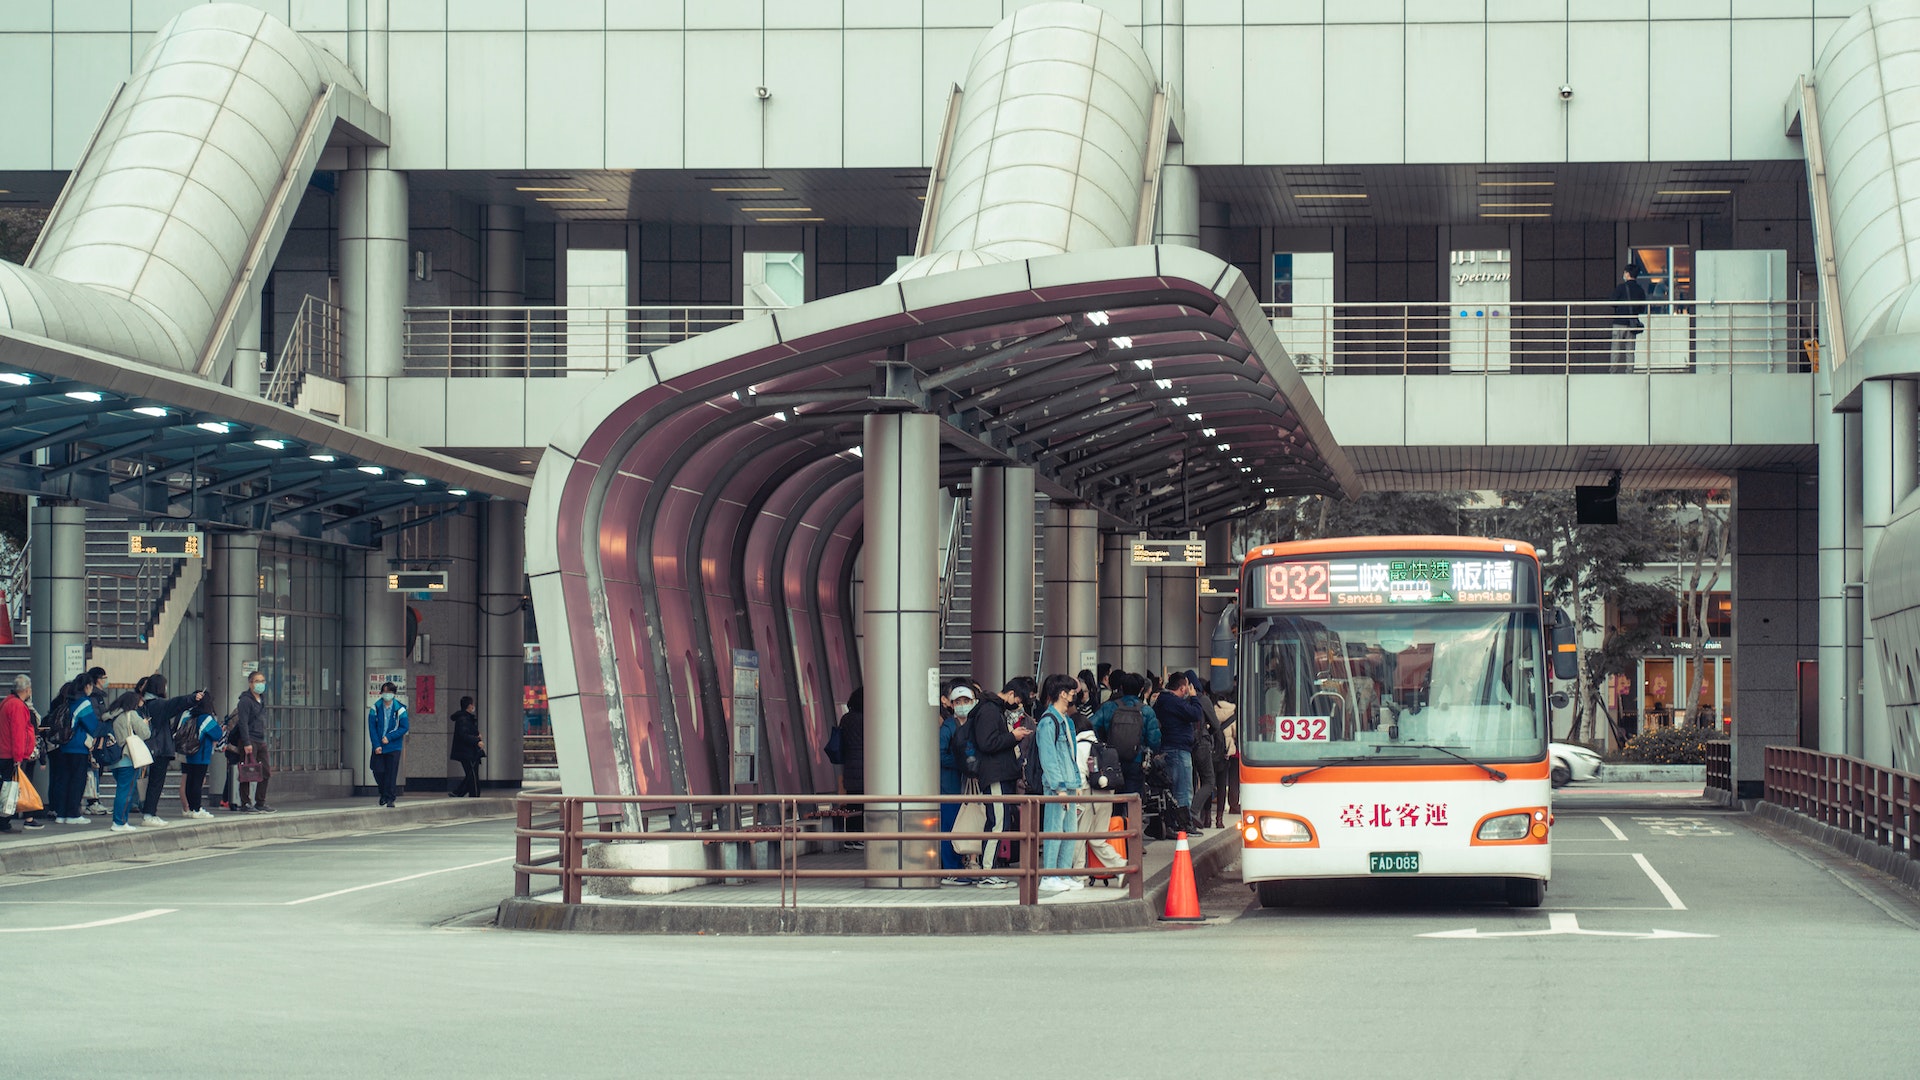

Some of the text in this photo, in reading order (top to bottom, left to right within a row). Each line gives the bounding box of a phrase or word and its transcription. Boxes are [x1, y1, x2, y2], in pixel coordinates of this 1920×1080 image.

[1329, 562, 1390, 593] 三峽
[1389, 560, 1450, 580] 最快速
[1452, 560, 1513, 591] 板橋
[1269, 565, 1328, 601] 932
[1338, 593, 1383, 604] Sanxia
[1458, 591, 1512, 603] Banqiao
[1280, 719, 1327, 741] 932
[1340, 803, 1449, 828] 臺北客運
